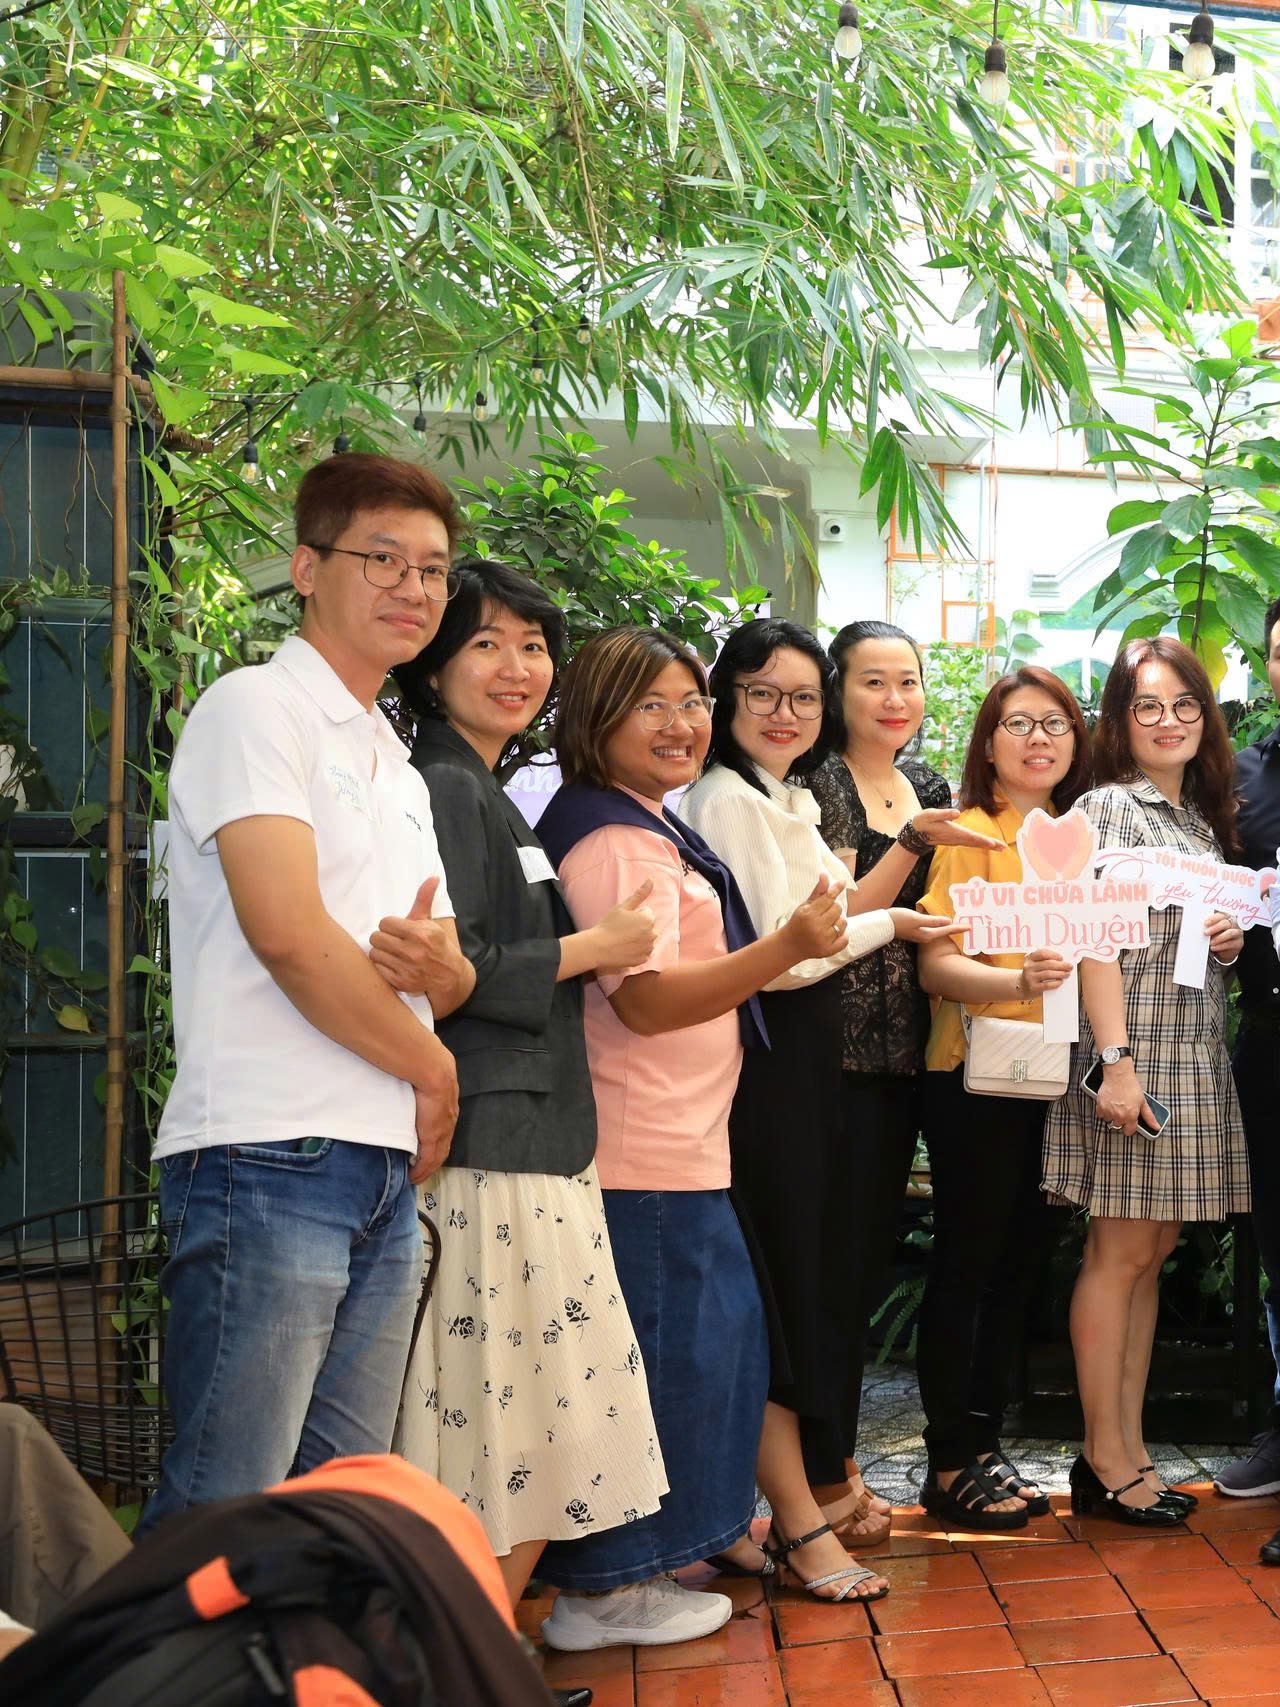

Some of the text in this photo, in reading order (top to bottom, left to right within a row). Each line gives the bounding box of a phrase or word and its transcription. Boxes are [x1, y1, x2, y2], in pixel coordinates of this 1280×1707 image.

[954, 878, 1147, 908] TỬ VI CHỮA LÀNH
[1156, 881, 1195, 904] yêu
[958, 913, 1146, 957] Tình Duyên
